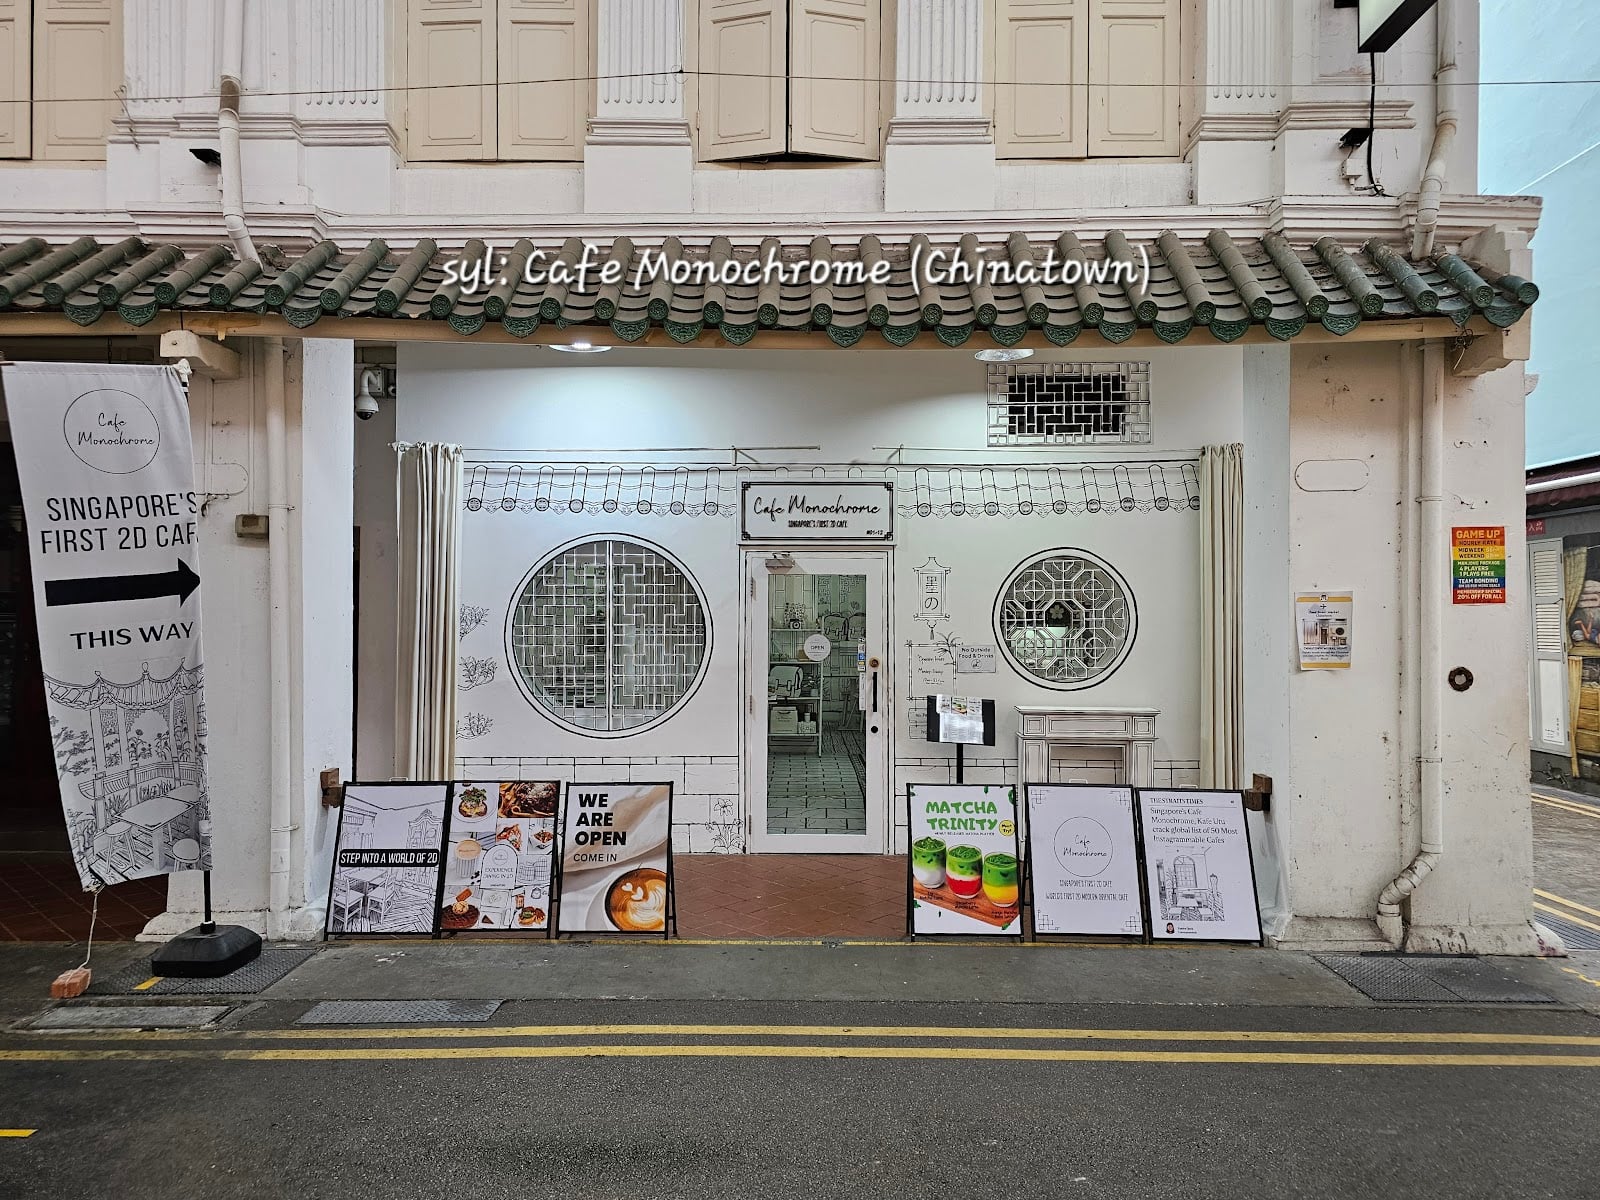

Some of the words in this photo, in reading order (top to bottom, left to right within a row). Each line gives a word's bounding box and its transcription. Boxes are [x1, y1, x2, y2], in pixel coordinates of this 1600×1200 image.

[98, 412, 127, 432] Cafe
[77, 431, 155, 448] Monochrome
[46, 491, 197, 522] SINGAPORE'S
[753, 496, 785, 522] Cafe
[787, 494, 881, 515] Monochrome
[40, 527, 108, 554] FIRST
[118, 526, 148, 550] 2D
[156, 522, 199, 549] CAF
[1456, 530, 1485, 539] GAME
[1486, 529, 1500, 538] UP
[69, 628, 133, 650] THIS
[138, 621, 194, 643] WAY
[578, 793, 608, 808] WE
[925, 801, 998, 814] MATCHA
[1150, 807, 1187, 816] Singapore's
[575, 812, 613, 827] ARE
[926, 818, 998, 830] TRINITY
[1151, 816, 1197, 825] Monochrome,
[1170, 826, 1191, 835] global
[574, 831, 627, 846] OPEN
[1075, 834, 1091, 849] Cafe
[1153, 835, 1205, 844] Instagrammable
[340, 852, 361, 864] STEP
[361, 852, 380, 864] INTO
[380, 852, 386, 864] A
[388, 852, 416, 864] WORLD
[416, 852, 426, 864] OF
[426, 852, 438, 864] 2D
[573, 853, 604, 862] COME
[606, 853, 617, 862] IN
[1063, 846, 1107, 857] Monochrome
